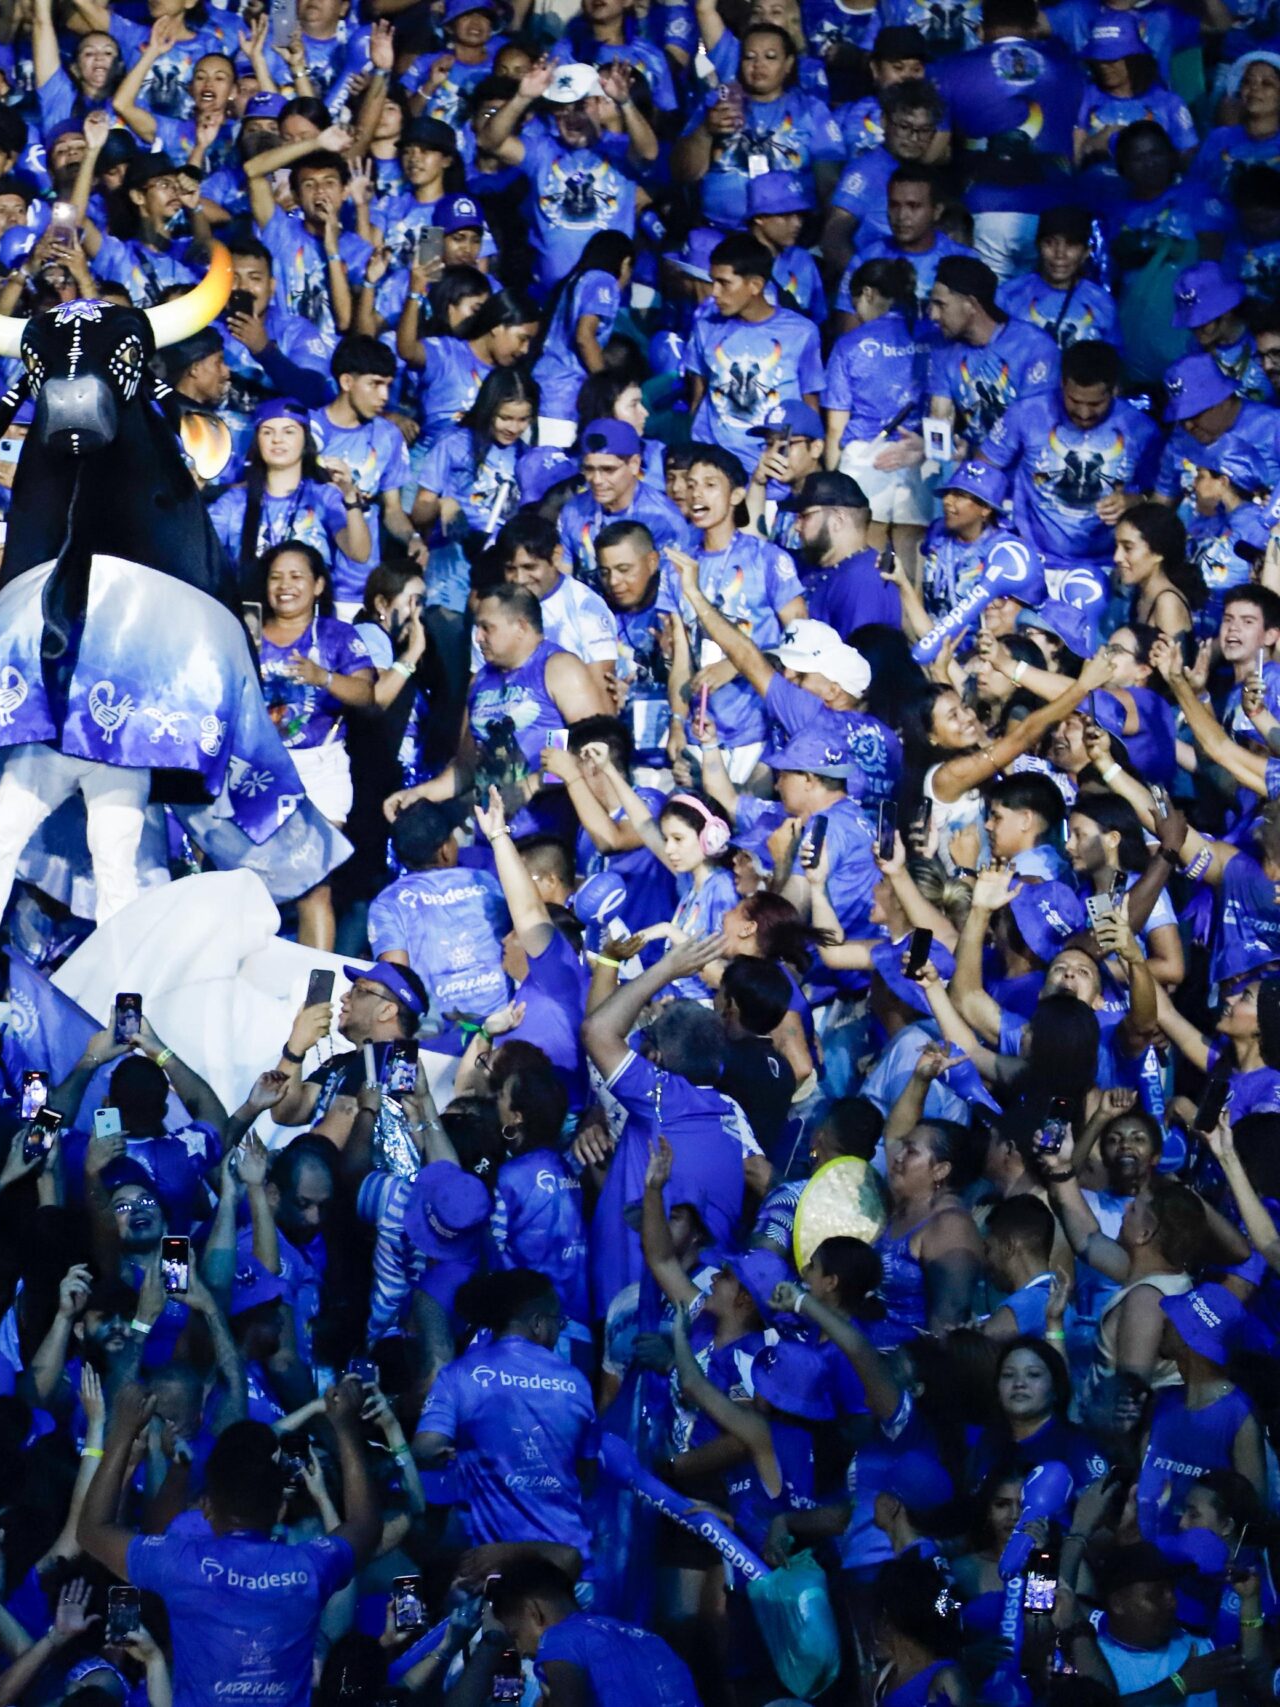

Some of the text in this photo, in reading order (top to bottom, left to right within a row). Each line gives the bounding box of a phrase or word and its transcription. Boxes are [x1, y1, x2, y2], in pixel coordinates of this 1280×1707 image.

[919, 584, 990, 650] bradesco
[500, 1370, 577, 1394] bradesco
[700, 1522, 764, 1583] radesco
[227, 1567, 309, 1591] bradesco
